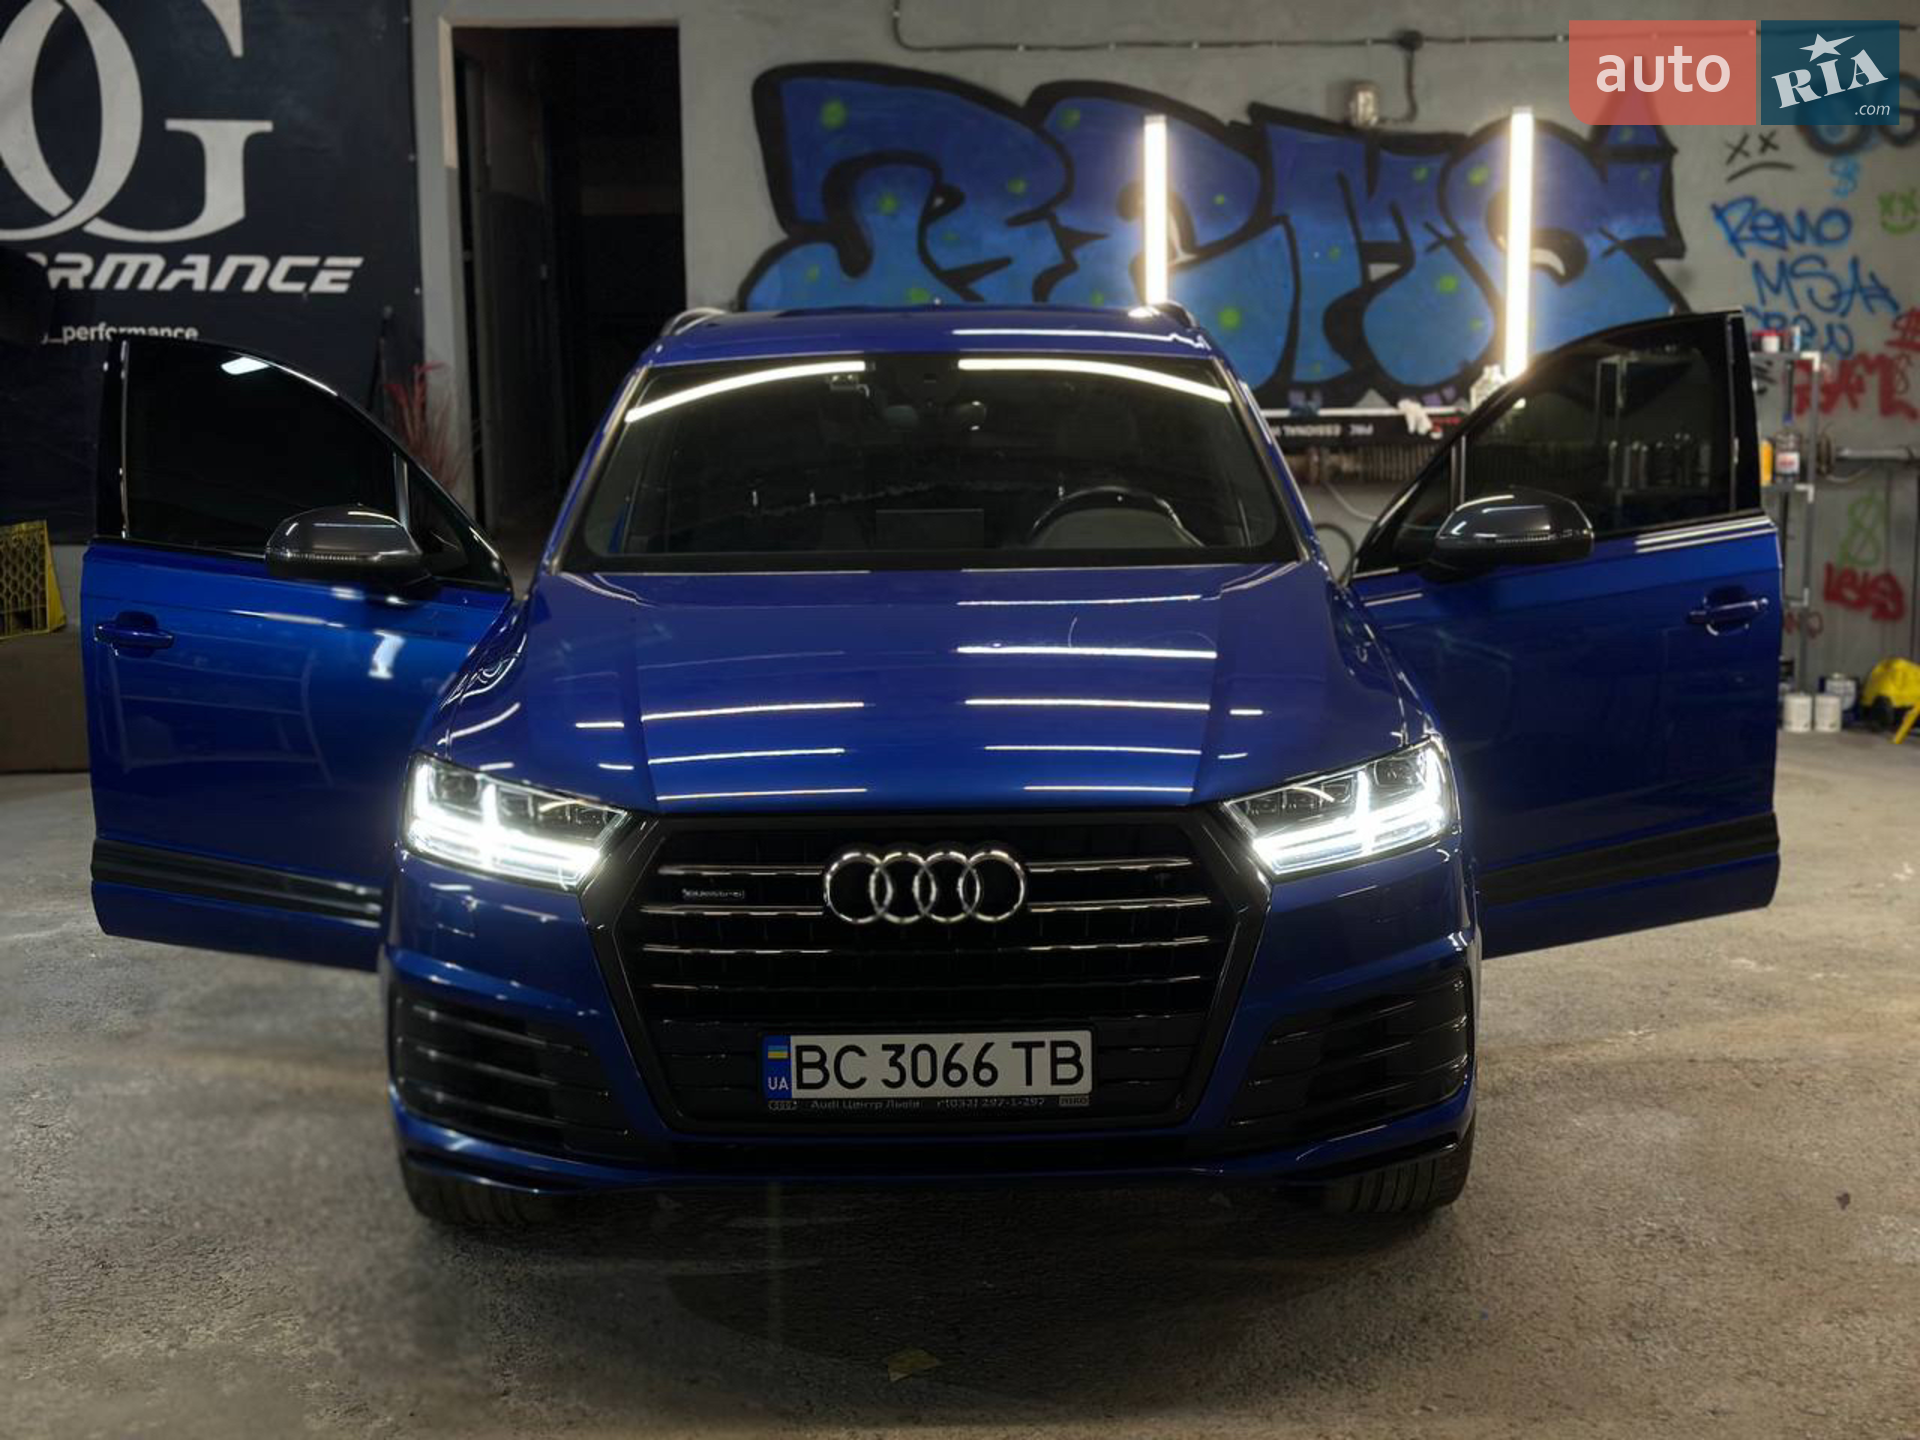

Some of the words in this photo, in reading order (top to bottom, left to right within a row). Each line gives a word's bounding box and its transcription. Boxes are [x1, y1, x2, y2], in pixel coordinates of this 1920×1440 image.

[26, 252, 363, 293] RMANCE
[767, 1075, 789, 1092] UA
[796, 1045, 867, 1089] BC
[881, 1042, 998, 1089] 3066
[1012, 1040, 1085, 1086] TB
